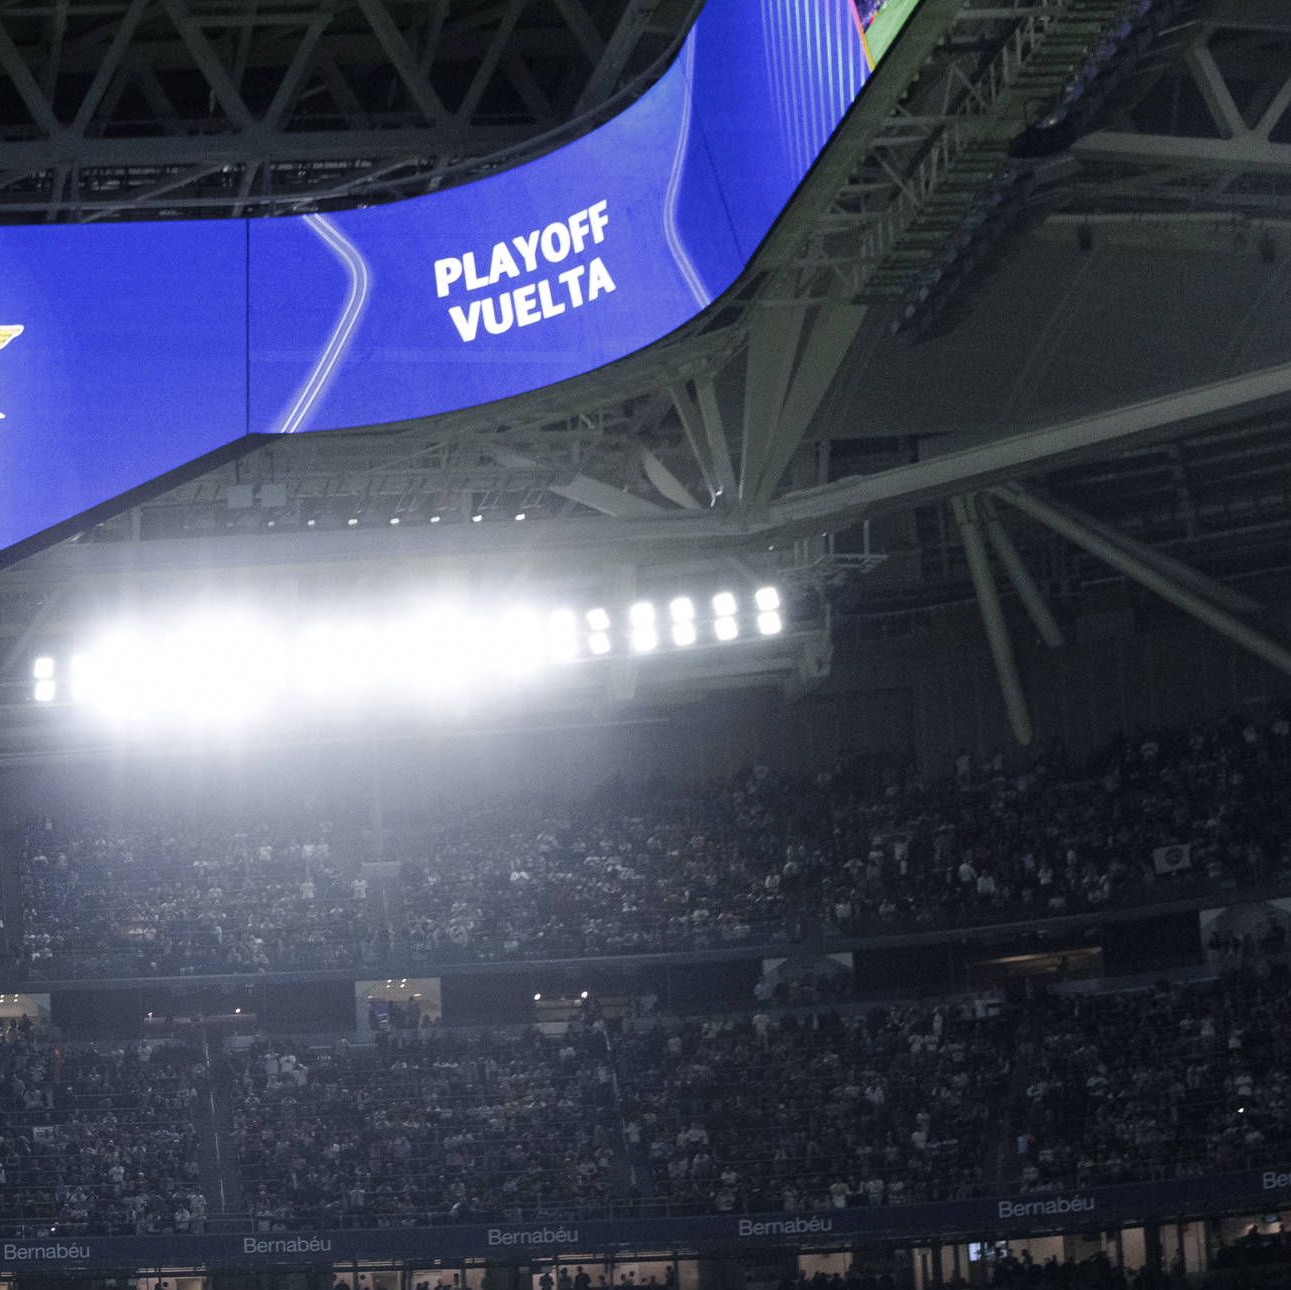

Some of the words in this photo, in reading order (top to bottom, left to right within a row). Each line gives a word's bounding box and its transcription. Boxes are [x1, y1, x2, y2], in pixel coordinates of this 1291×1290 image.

[434, 199, 609, 298] PLAYOFF
[448, 256, 617, 343] VUELTA
[997, 1195, 1095, 1219] Bernabéu
[488, 1226, 578, 1247] Bernabéu
[738, 1214, 833, 1237] Bernabéu
[3, 1241, 90, 1261] Bernabéu
[243, 1235, 332, 1254] Bernabéu
